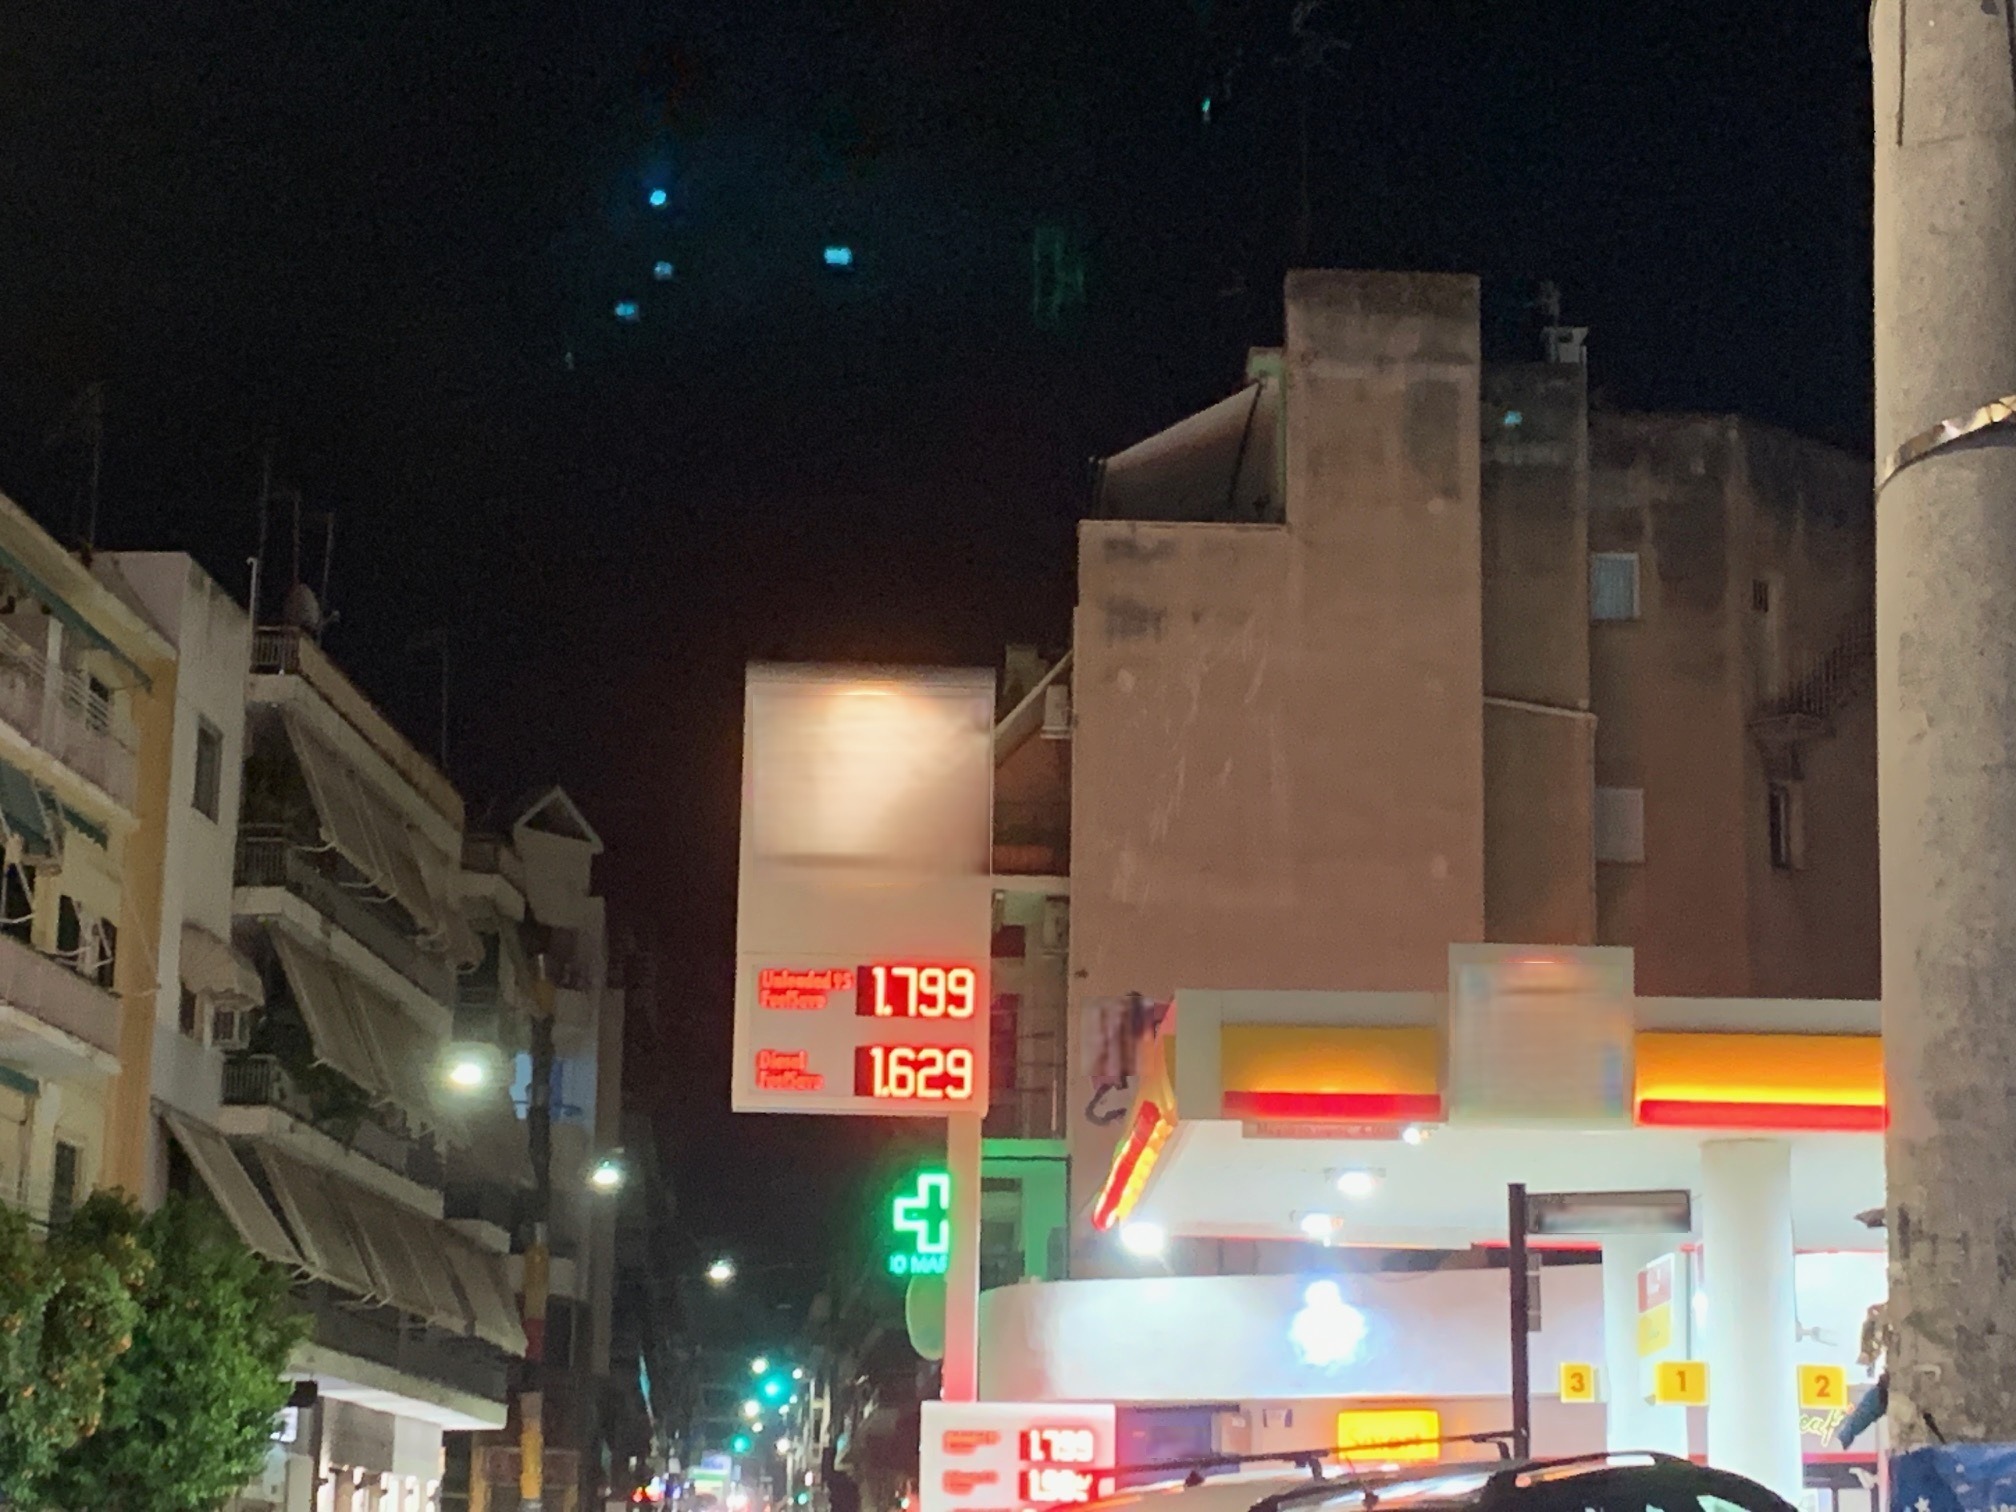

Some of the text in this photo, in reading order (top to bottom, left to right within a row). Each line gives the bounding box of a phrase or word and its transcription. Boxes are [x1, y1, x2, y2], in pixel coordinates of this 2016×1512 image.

[872, 966, 975, 1018] 1.799
[870, 1047, 973, 1099] 1.629
[1570, 1373, 1585, 1393] 3
[1675, 1370, 1687, 1393] 1
[1815, 1375, 1831, 1397] 2
